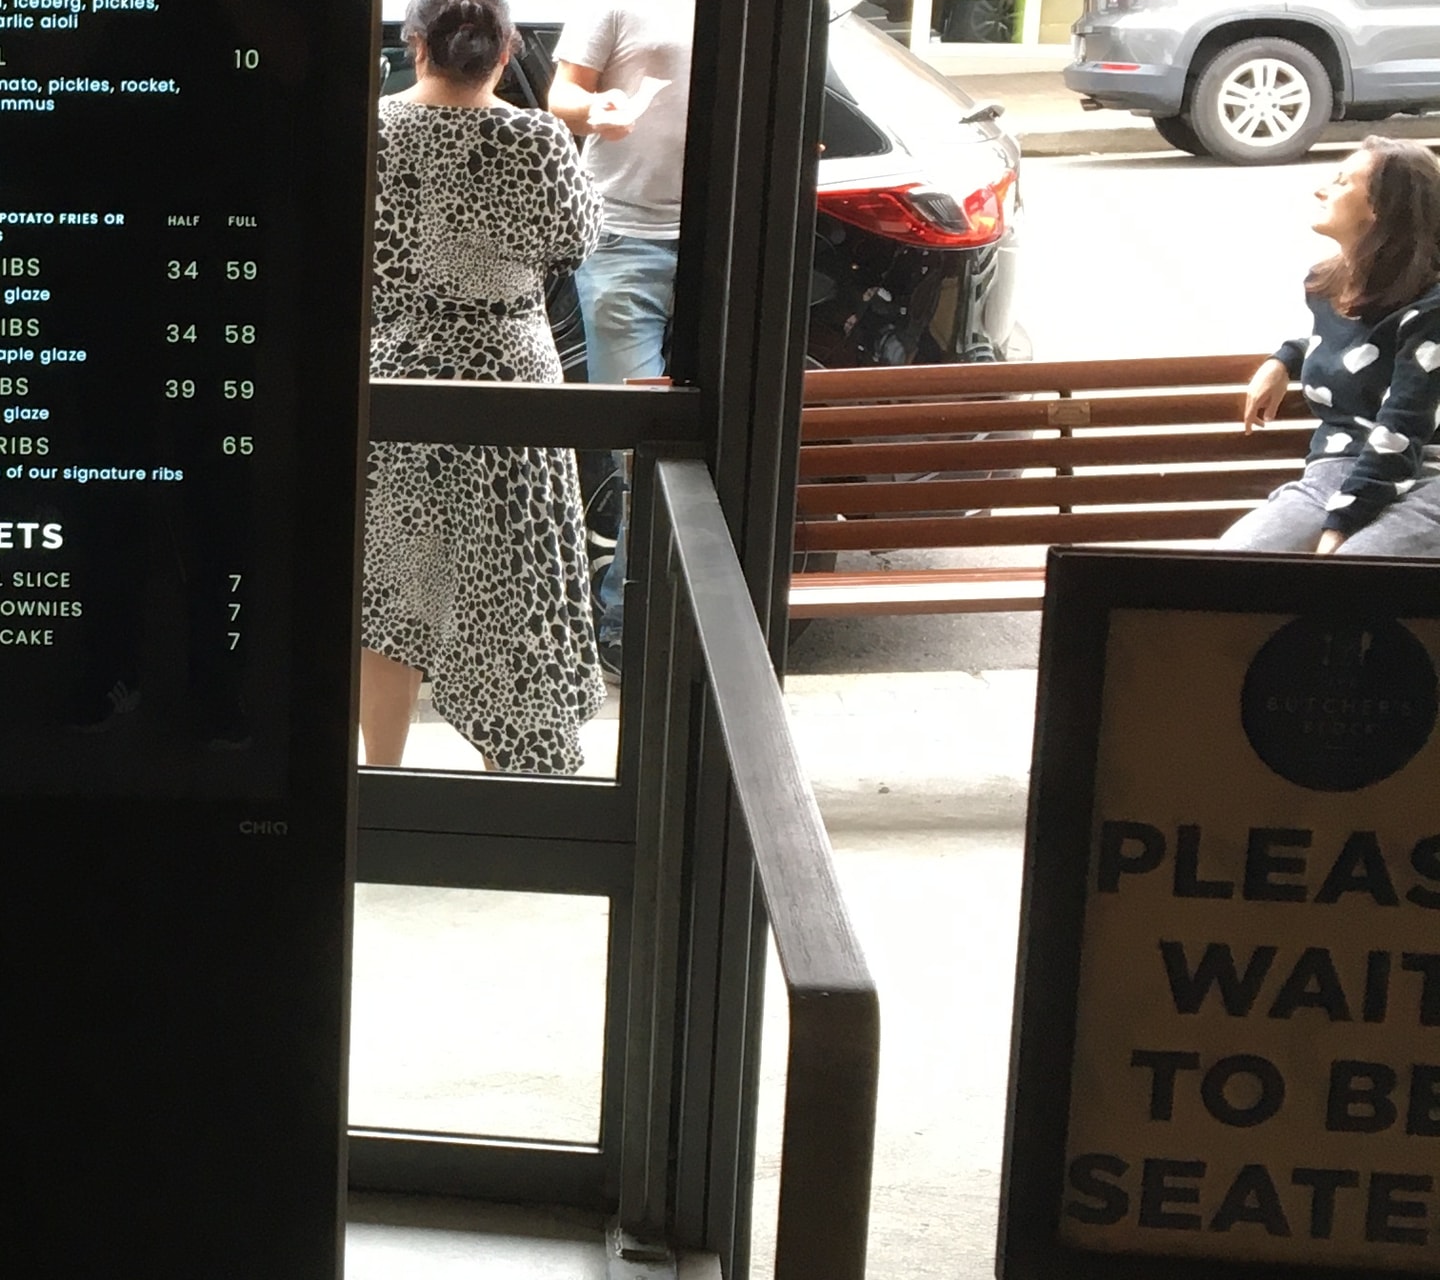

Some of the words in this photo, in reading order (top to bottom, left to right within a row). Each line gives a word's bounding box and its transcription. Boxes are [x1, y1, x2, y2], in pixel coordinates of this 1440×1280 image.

[234, 49, 259, 69] 10
[167, 215, 200, 227] HALF
[228, 215, 258, 228] FULL
[167, 260, 199, 280] 34
[226, 260, 257, 280] 59
[166, 323, 198, 343] 34
[225, 324, 256, 345] 58
[39, 347, 87, 365] glaze
[165, 379, 195, 399] 39
[224, 380, 254, 400] 59
[222, 435, 254, 455] 65
[6, 464, 23, 479] of
[28, 467, 58, 479] our
[63, 465, 147, 484] signature
[152, 466, 184, 481] ribs
[12, 571, 70, 588] SLICE
[228, 574, 242, 593] 7
[228, 603, 241, 622] 7
[0, 629, 54, 646] CAKE
[227, 632, 241, 651] 7
[1157, 938, 1440, 1026] WAIT
[1130, 1049, 1286, 1129] TO
[1067, 1152, 1435, 1246] SEATE
